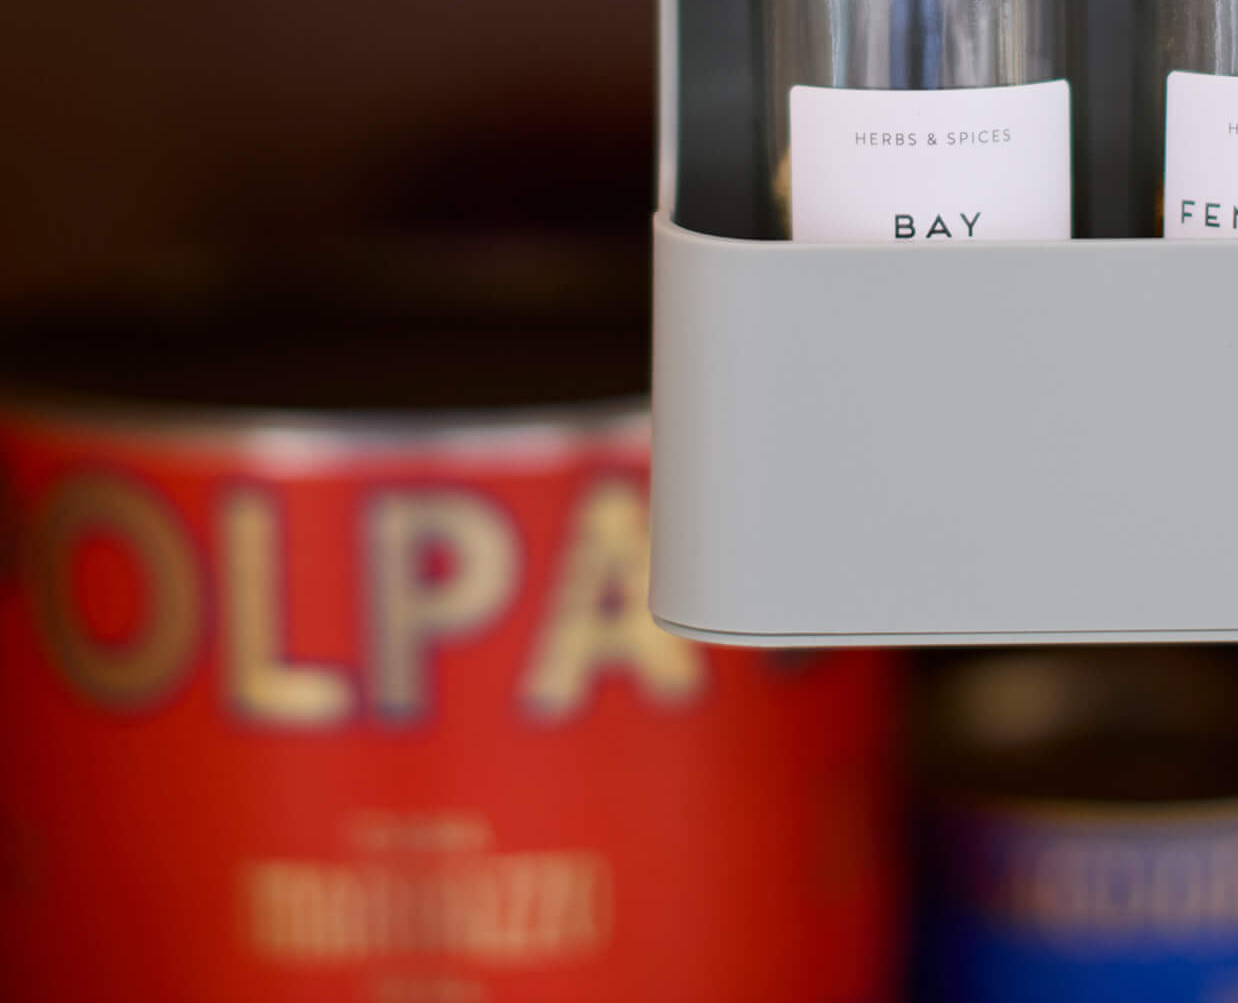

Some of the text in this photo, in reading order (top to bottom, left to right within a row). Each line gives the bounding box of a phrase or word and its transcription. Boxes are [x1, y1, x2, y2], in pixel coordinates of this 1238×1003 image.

[855, 128, 1012, 146] HERBS & SPICES
[894, 211, 983, 240] BAY
